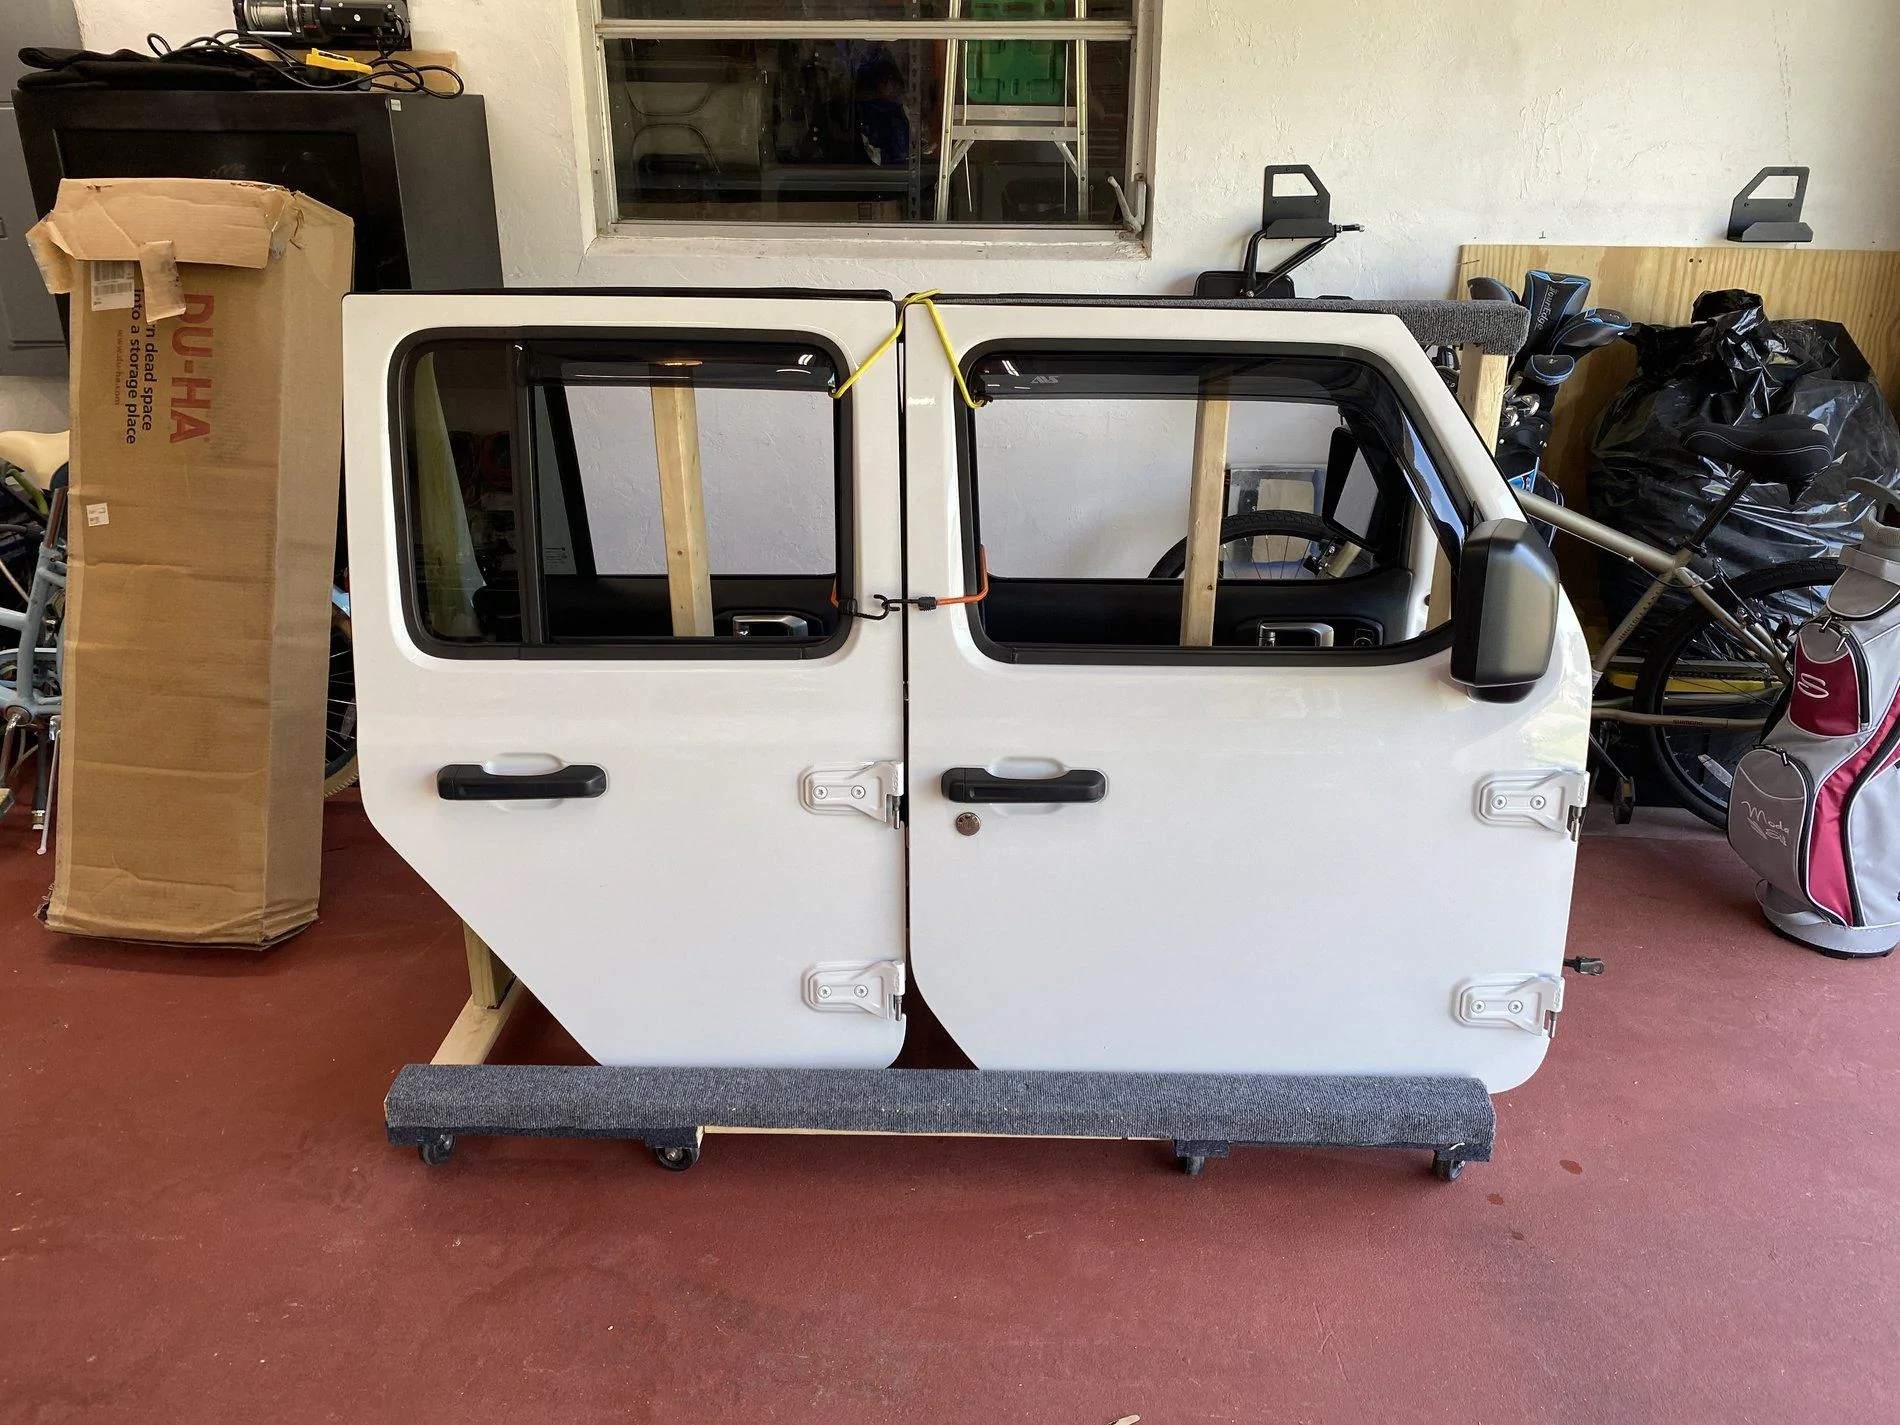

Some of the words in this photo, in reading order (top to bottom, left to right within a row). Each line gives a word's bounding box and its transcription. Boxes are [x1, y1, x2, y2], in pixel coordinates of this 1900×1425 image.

[132, 289, 144, 320] into
[131, 325, 139, 334] a
[114, 330, 123, 406] www.du-ha.com
[126, 339, 141, 399] storage
[145, 342, 158, 382] dead
[170, 294, 214, 443] DU-HA
[125, 403, 140, 444] place
[140, 387, 153, 431] space
[1741, 801, 1790, 836] Moda
